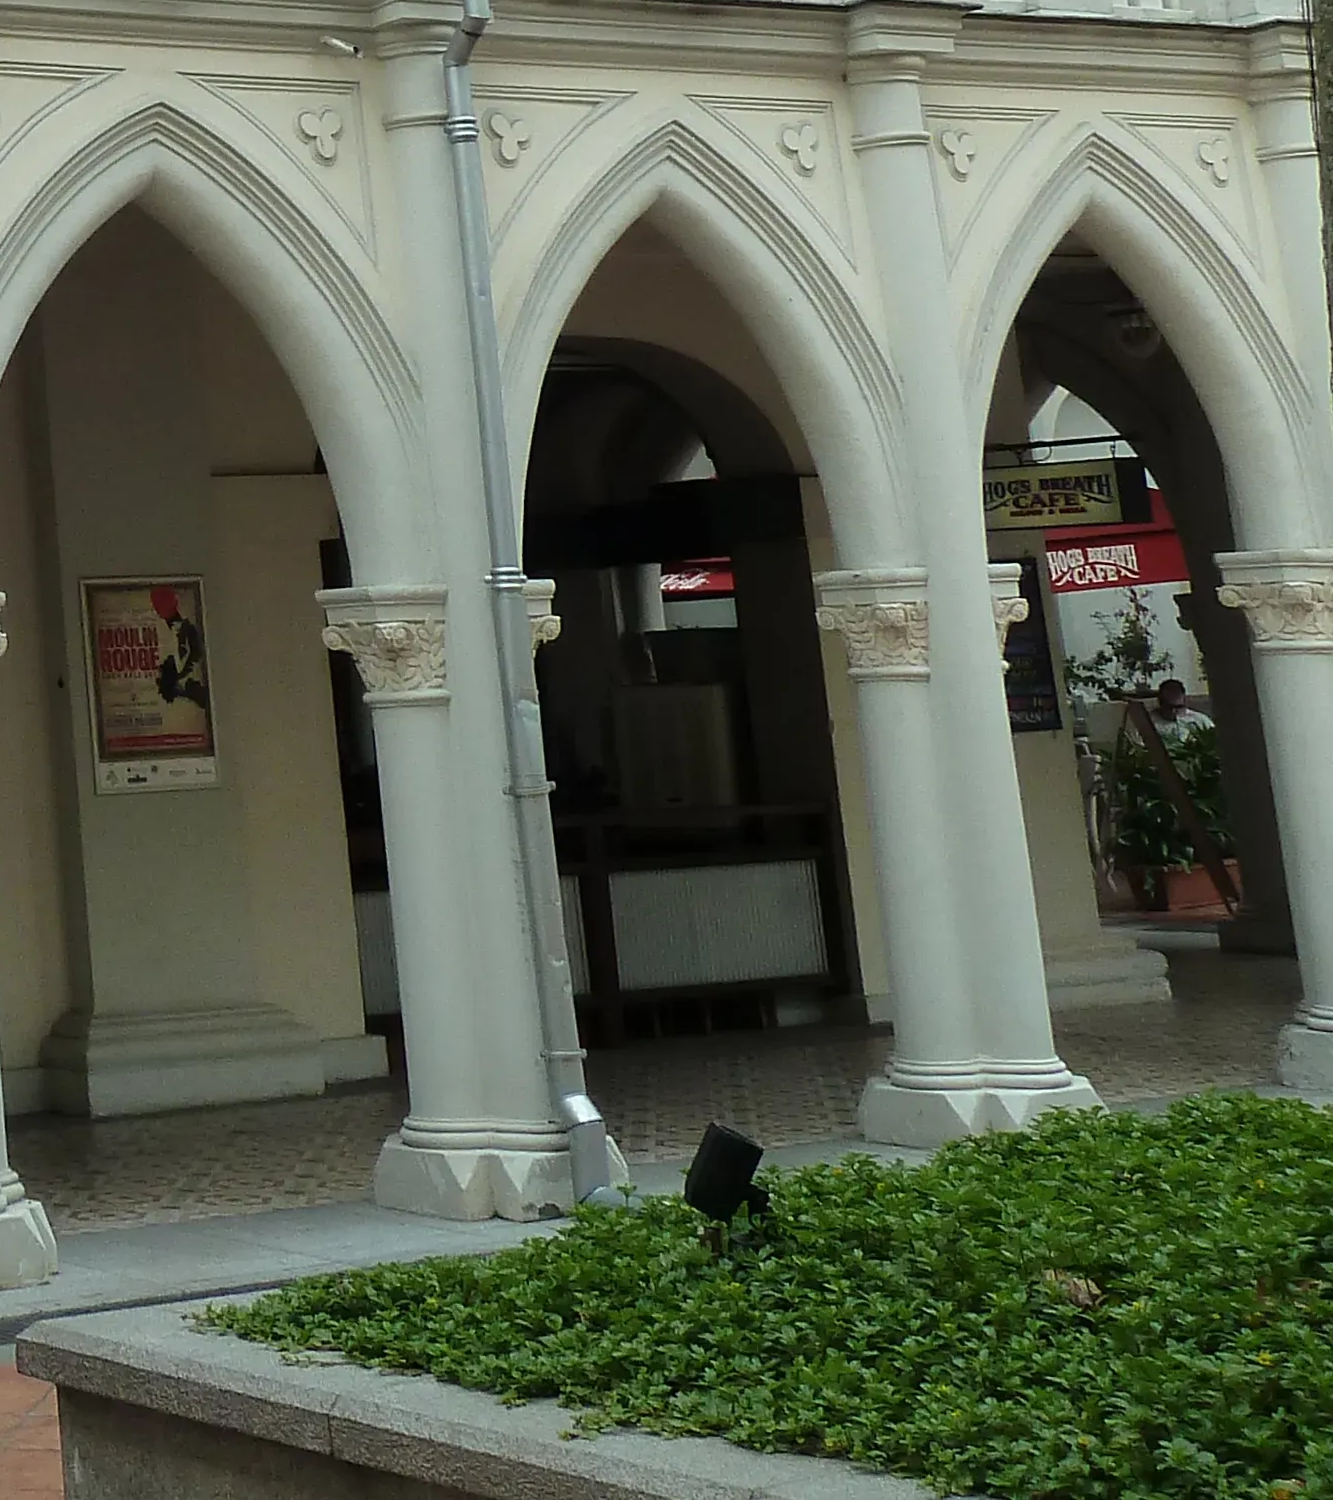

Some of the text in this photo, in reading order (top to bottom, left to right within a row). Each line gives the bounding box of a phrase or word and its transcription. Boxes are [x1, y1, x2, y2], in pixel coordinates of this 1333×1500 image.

[1039, 474, 1112, 498] BREATH
[1012, 493, 1080, 509] CAFE
[1073, 564, 1119, 585] CAFE
[98, 626, 159, 647] MOULIN
